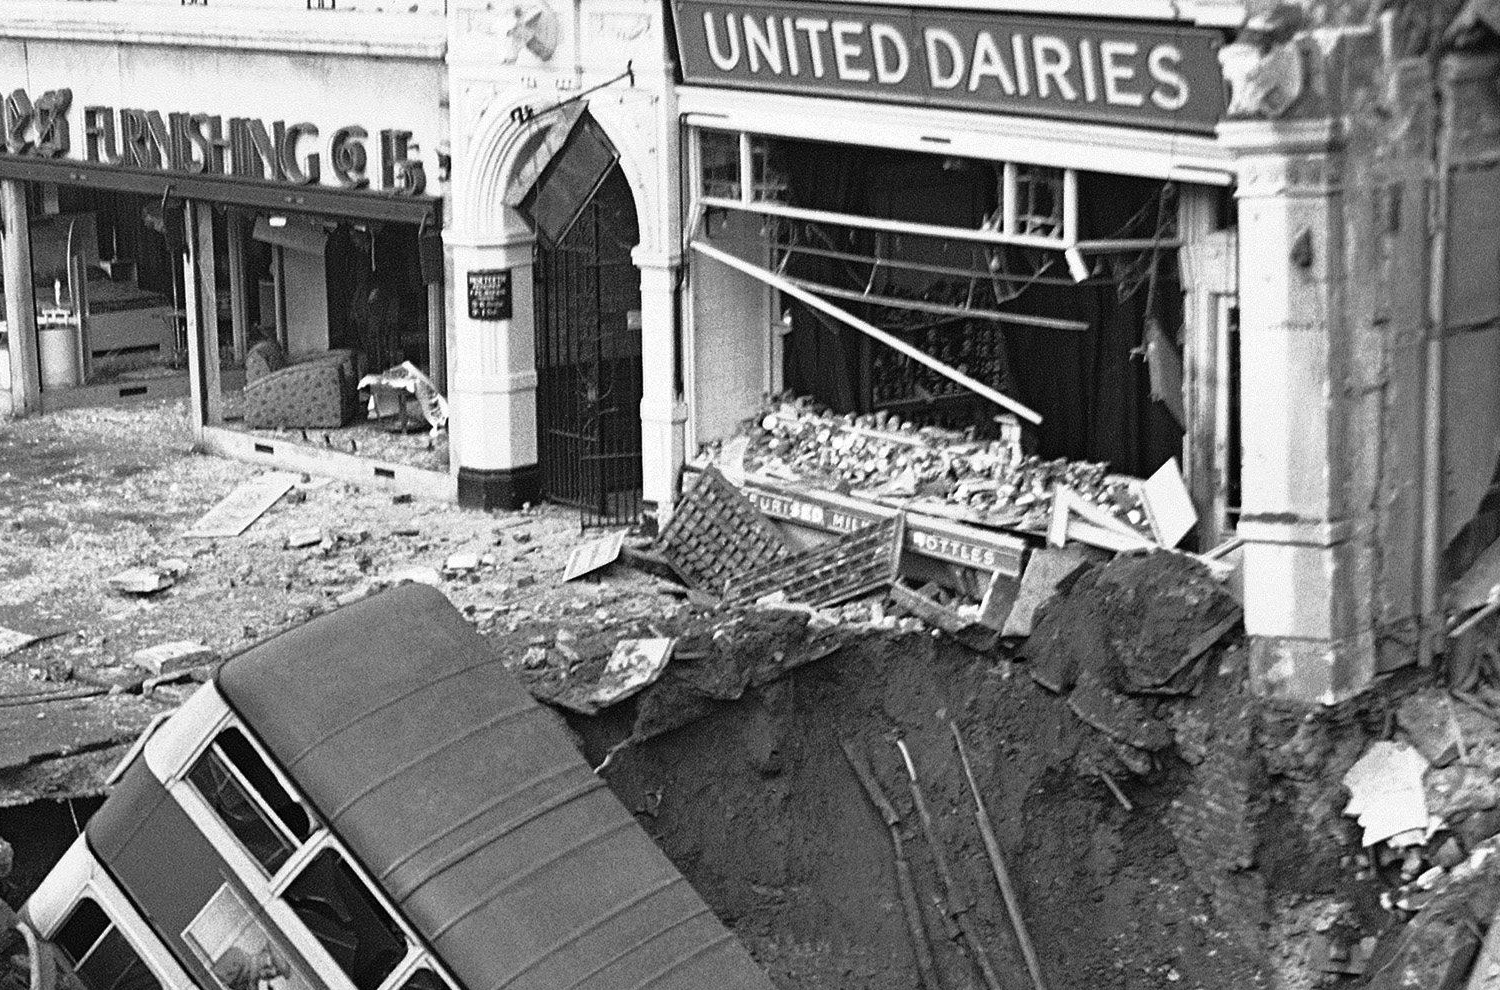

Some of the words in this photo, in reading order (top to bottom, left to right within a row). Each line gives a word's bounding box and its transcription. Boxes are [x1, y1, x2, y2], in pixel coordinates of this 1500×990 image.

[703, 12, 910, 84] UNITED
[924, 27, 1189, 110] DAIRIES
[84, 105, 320, 186] FURNISHING
[913, 531, 996, 565] BOTTLES
